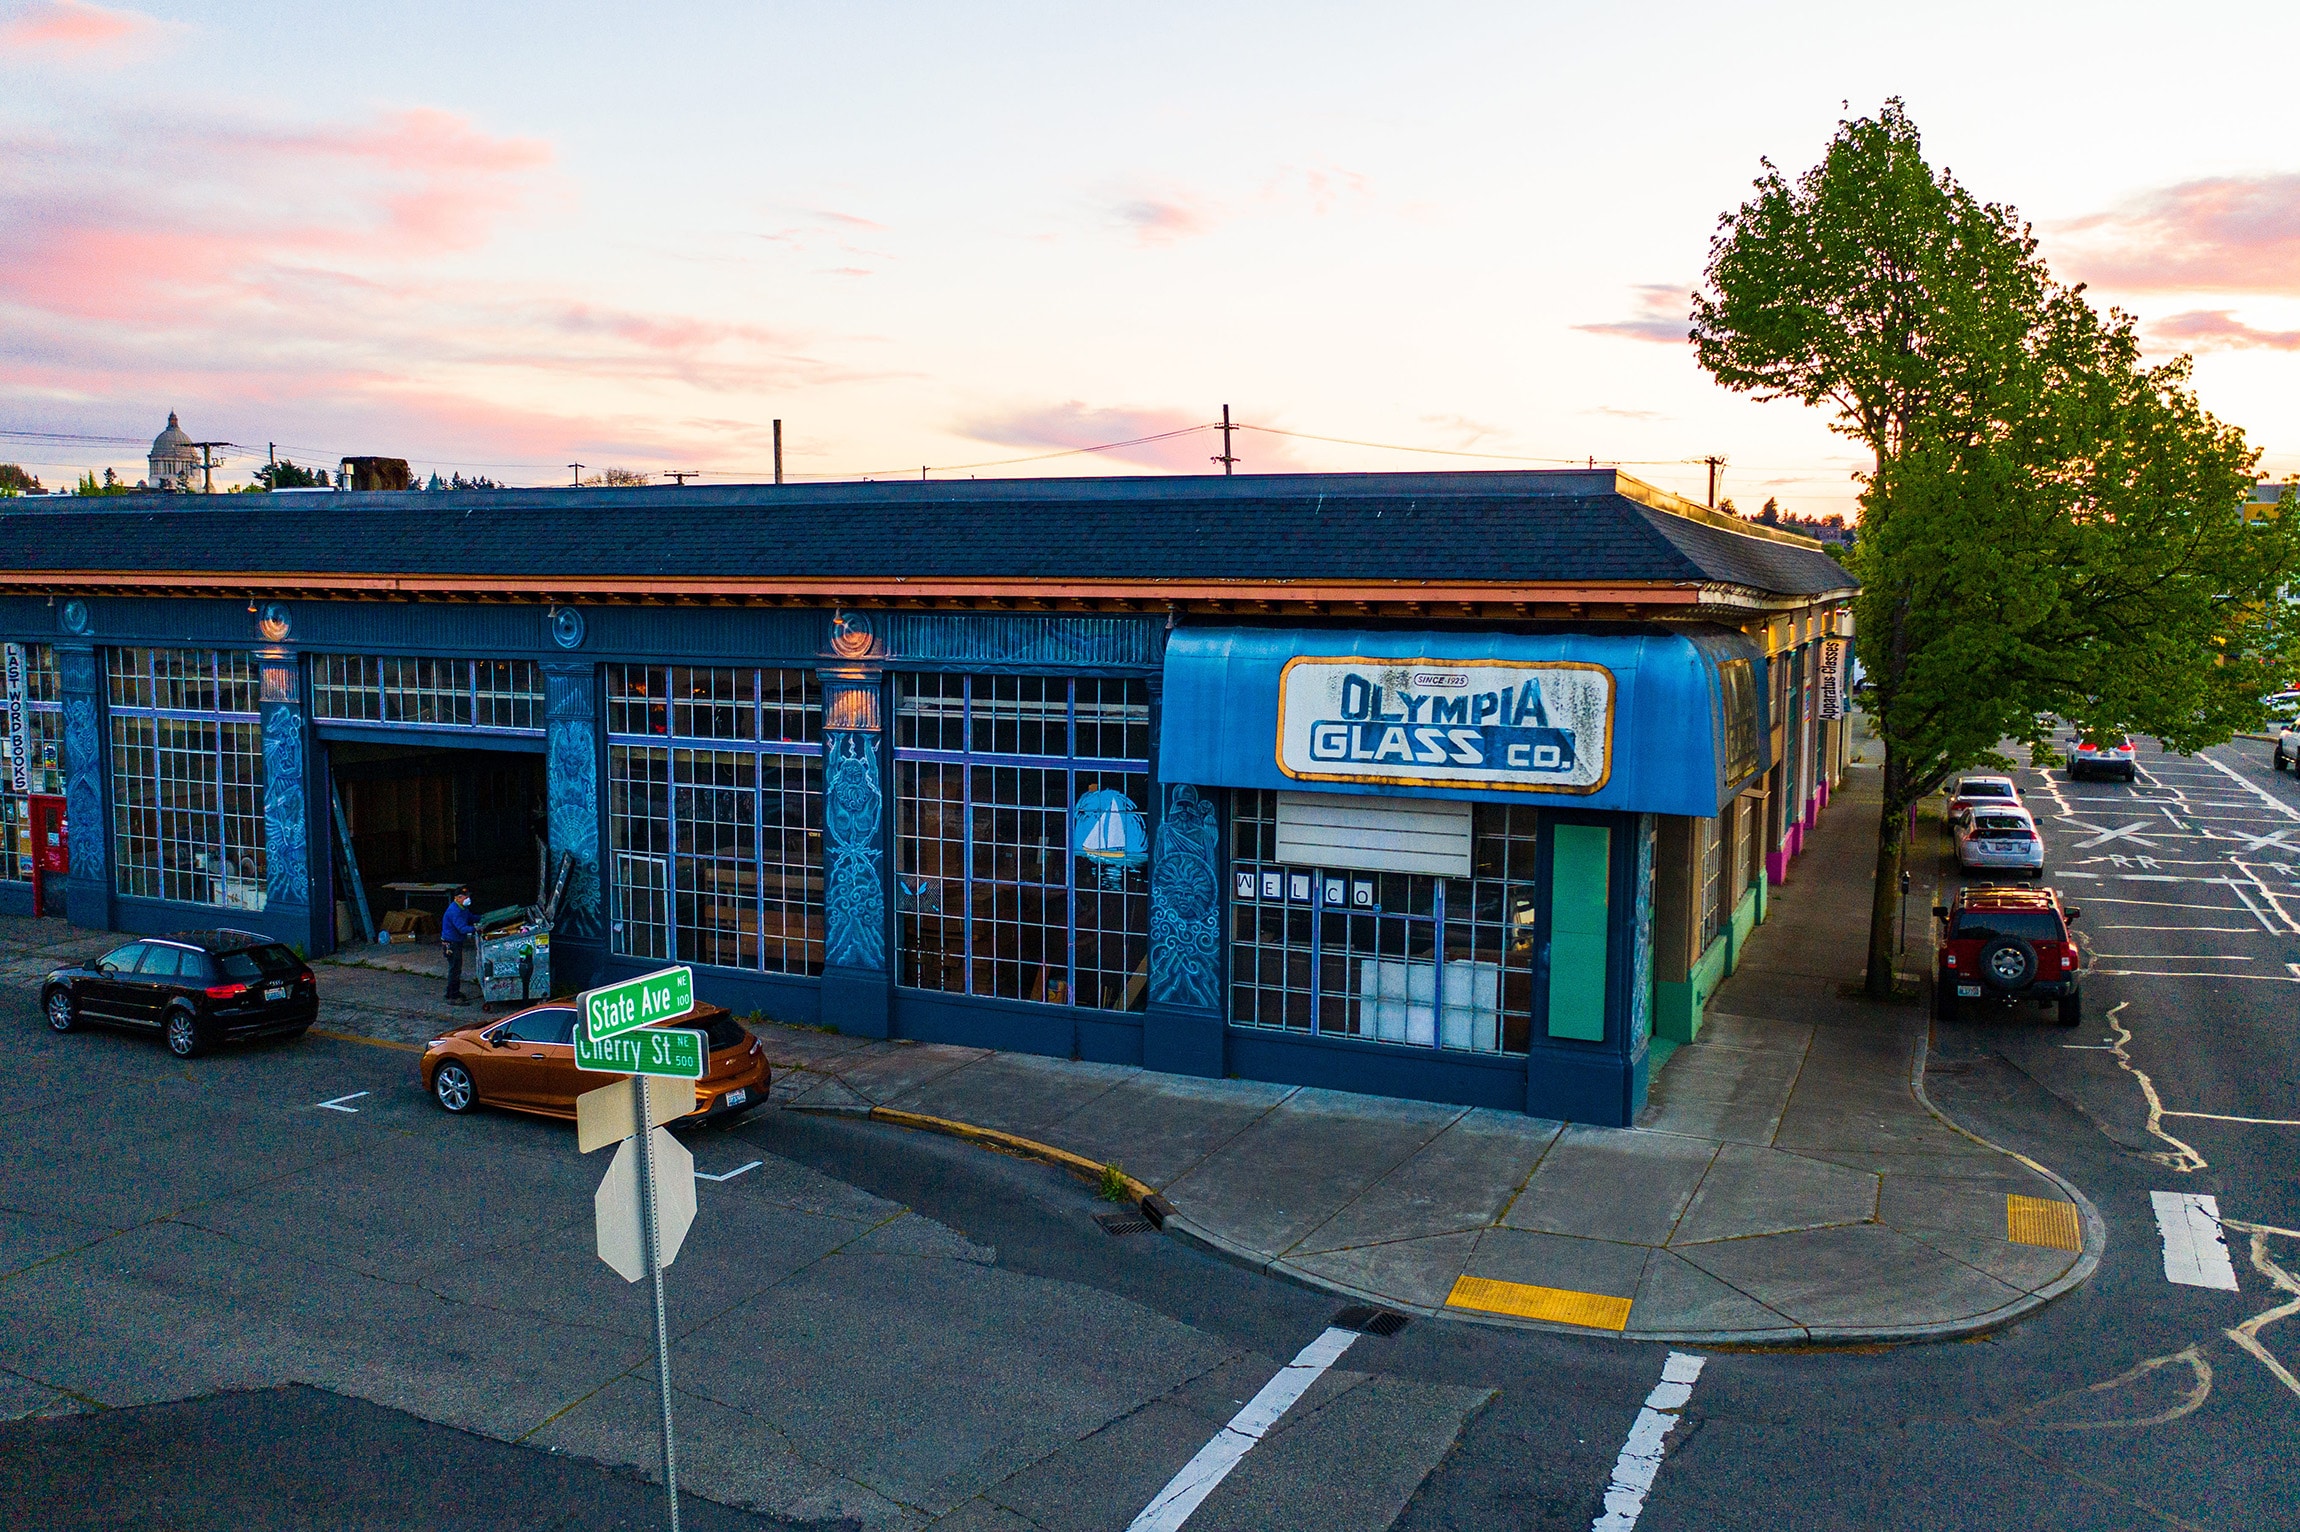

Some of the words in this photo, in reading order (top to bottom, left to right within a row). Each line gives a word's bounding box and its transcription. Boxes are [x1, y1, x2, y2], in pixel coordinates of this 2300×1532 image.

[7, 645, 18, 689] LAST
[1821, 641, 1840, 673] Classes
[1340, 672, 1549, 727] OLYMPIA
[1418, 676, 1445, 684] SINCE
[1447, 677, 1465, 685] 1925
[1820, 676, 1839, 720] Apparatus
[9, 691, 22, 733] WORD
[12, 735, 26, 789] BOOKS
[1313, 723, 1484, 764] GLASS
[1507, 744, 1571, 769] CO.
[676, 994, 690, 1007] 100
[677, 975, 687, 987] NE
[592, 993, 635, 1031] State
[641, 986, 671, 1017] Ave
[580, 1037, 641, 1071] Cherry
[651, 1033, 672, 1065] St
[675, 1055, 694, 1067] 500
[677, 1036, 689, 1047] NE
